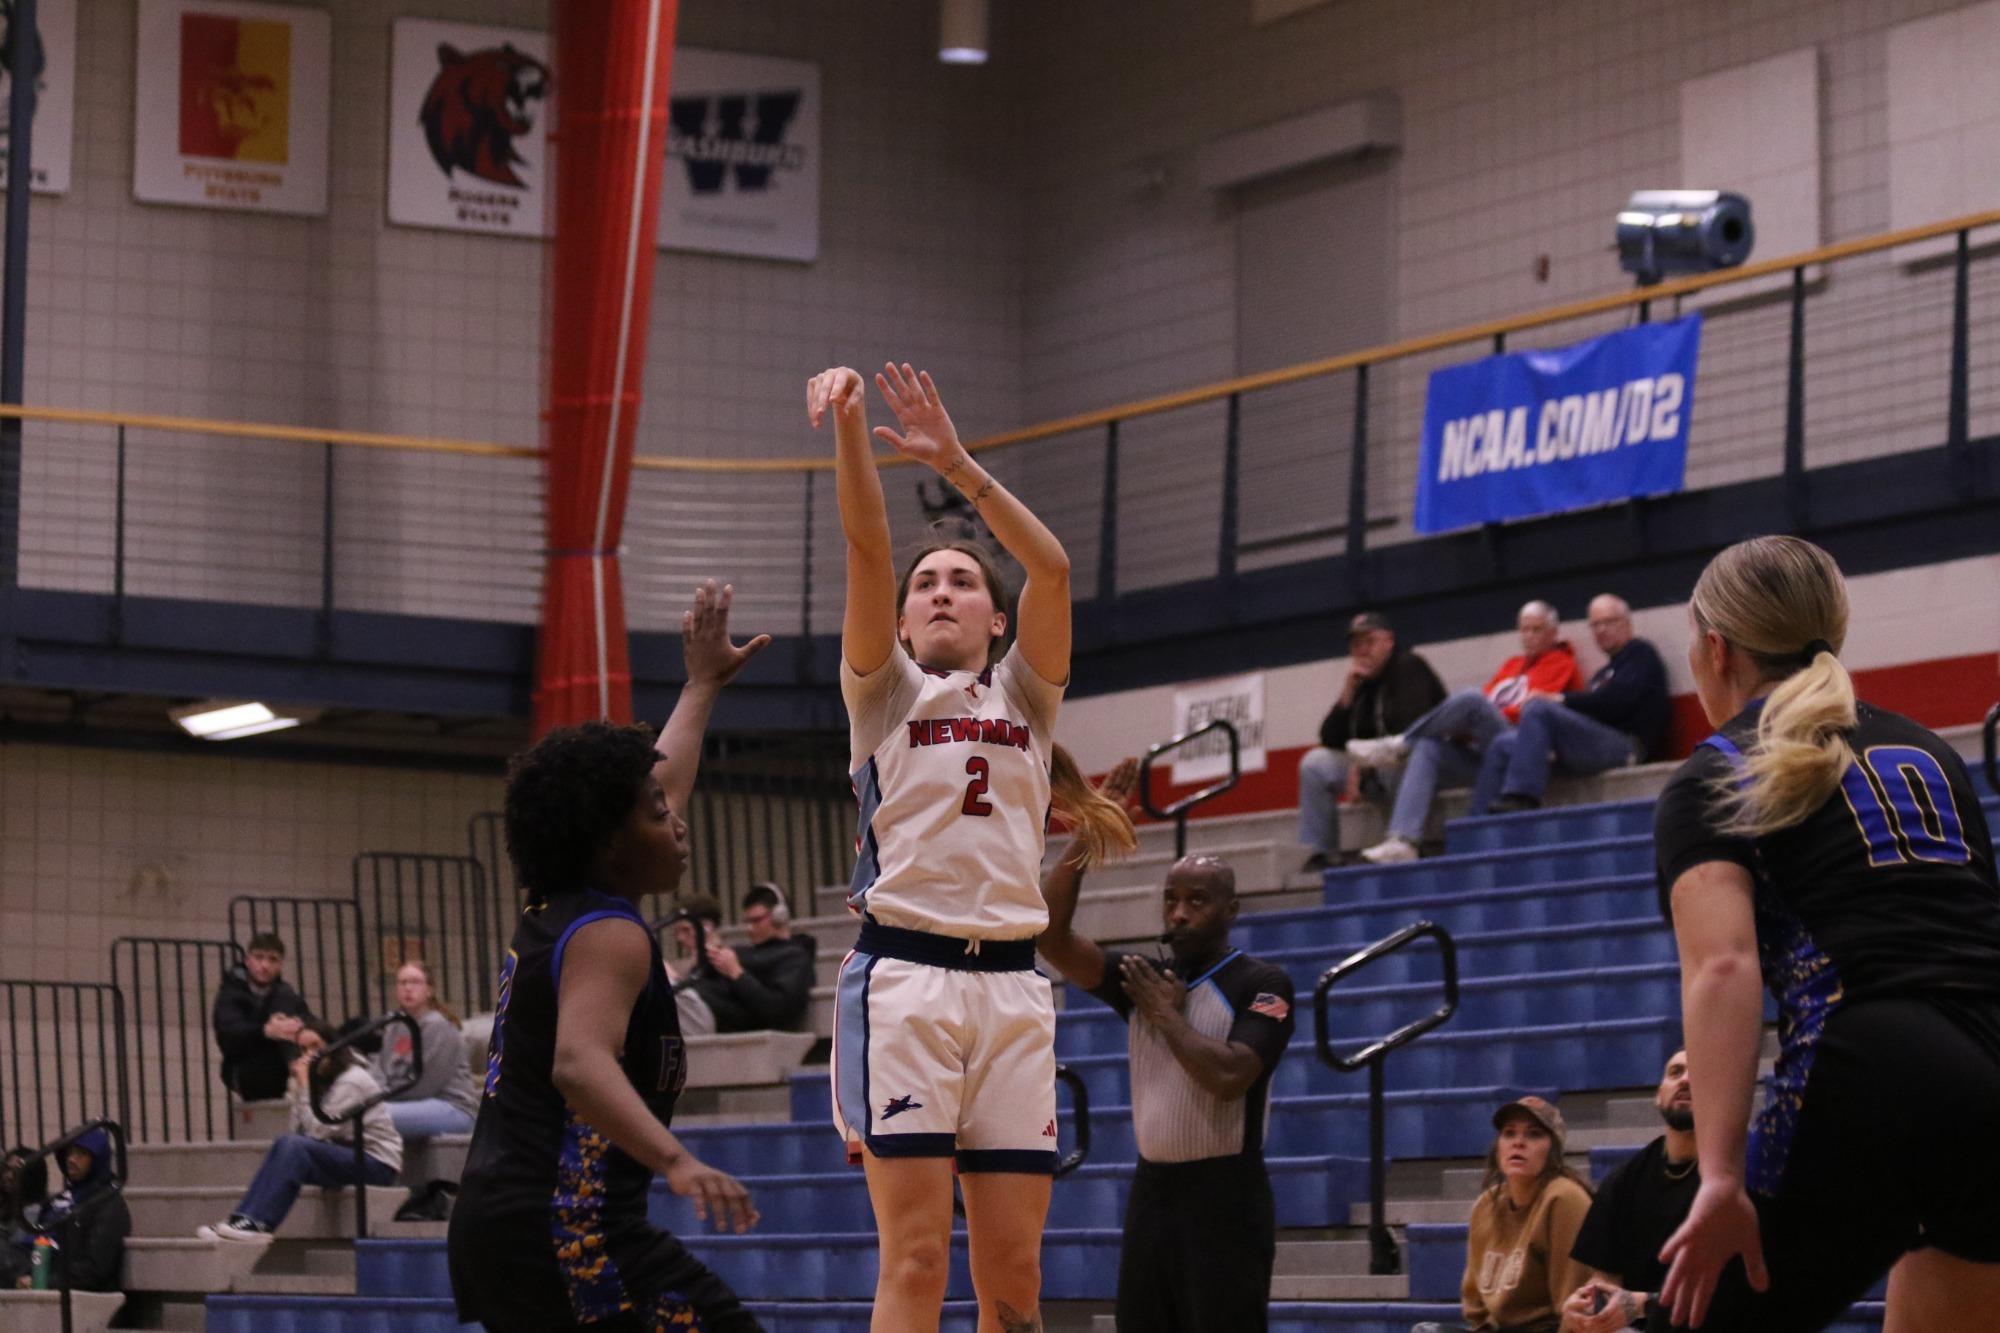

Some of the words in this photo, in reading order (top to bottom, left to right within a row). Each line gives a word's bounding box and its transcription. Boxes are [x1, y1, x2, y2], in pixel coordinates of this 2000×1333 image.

[1437, 373, 1685, 483] NCAA.COM/D2
[907, 718, 1031, 752] NEWMAN
[961, 756, 993, 817] 2
[1841, 745, 1971, 868] 10
